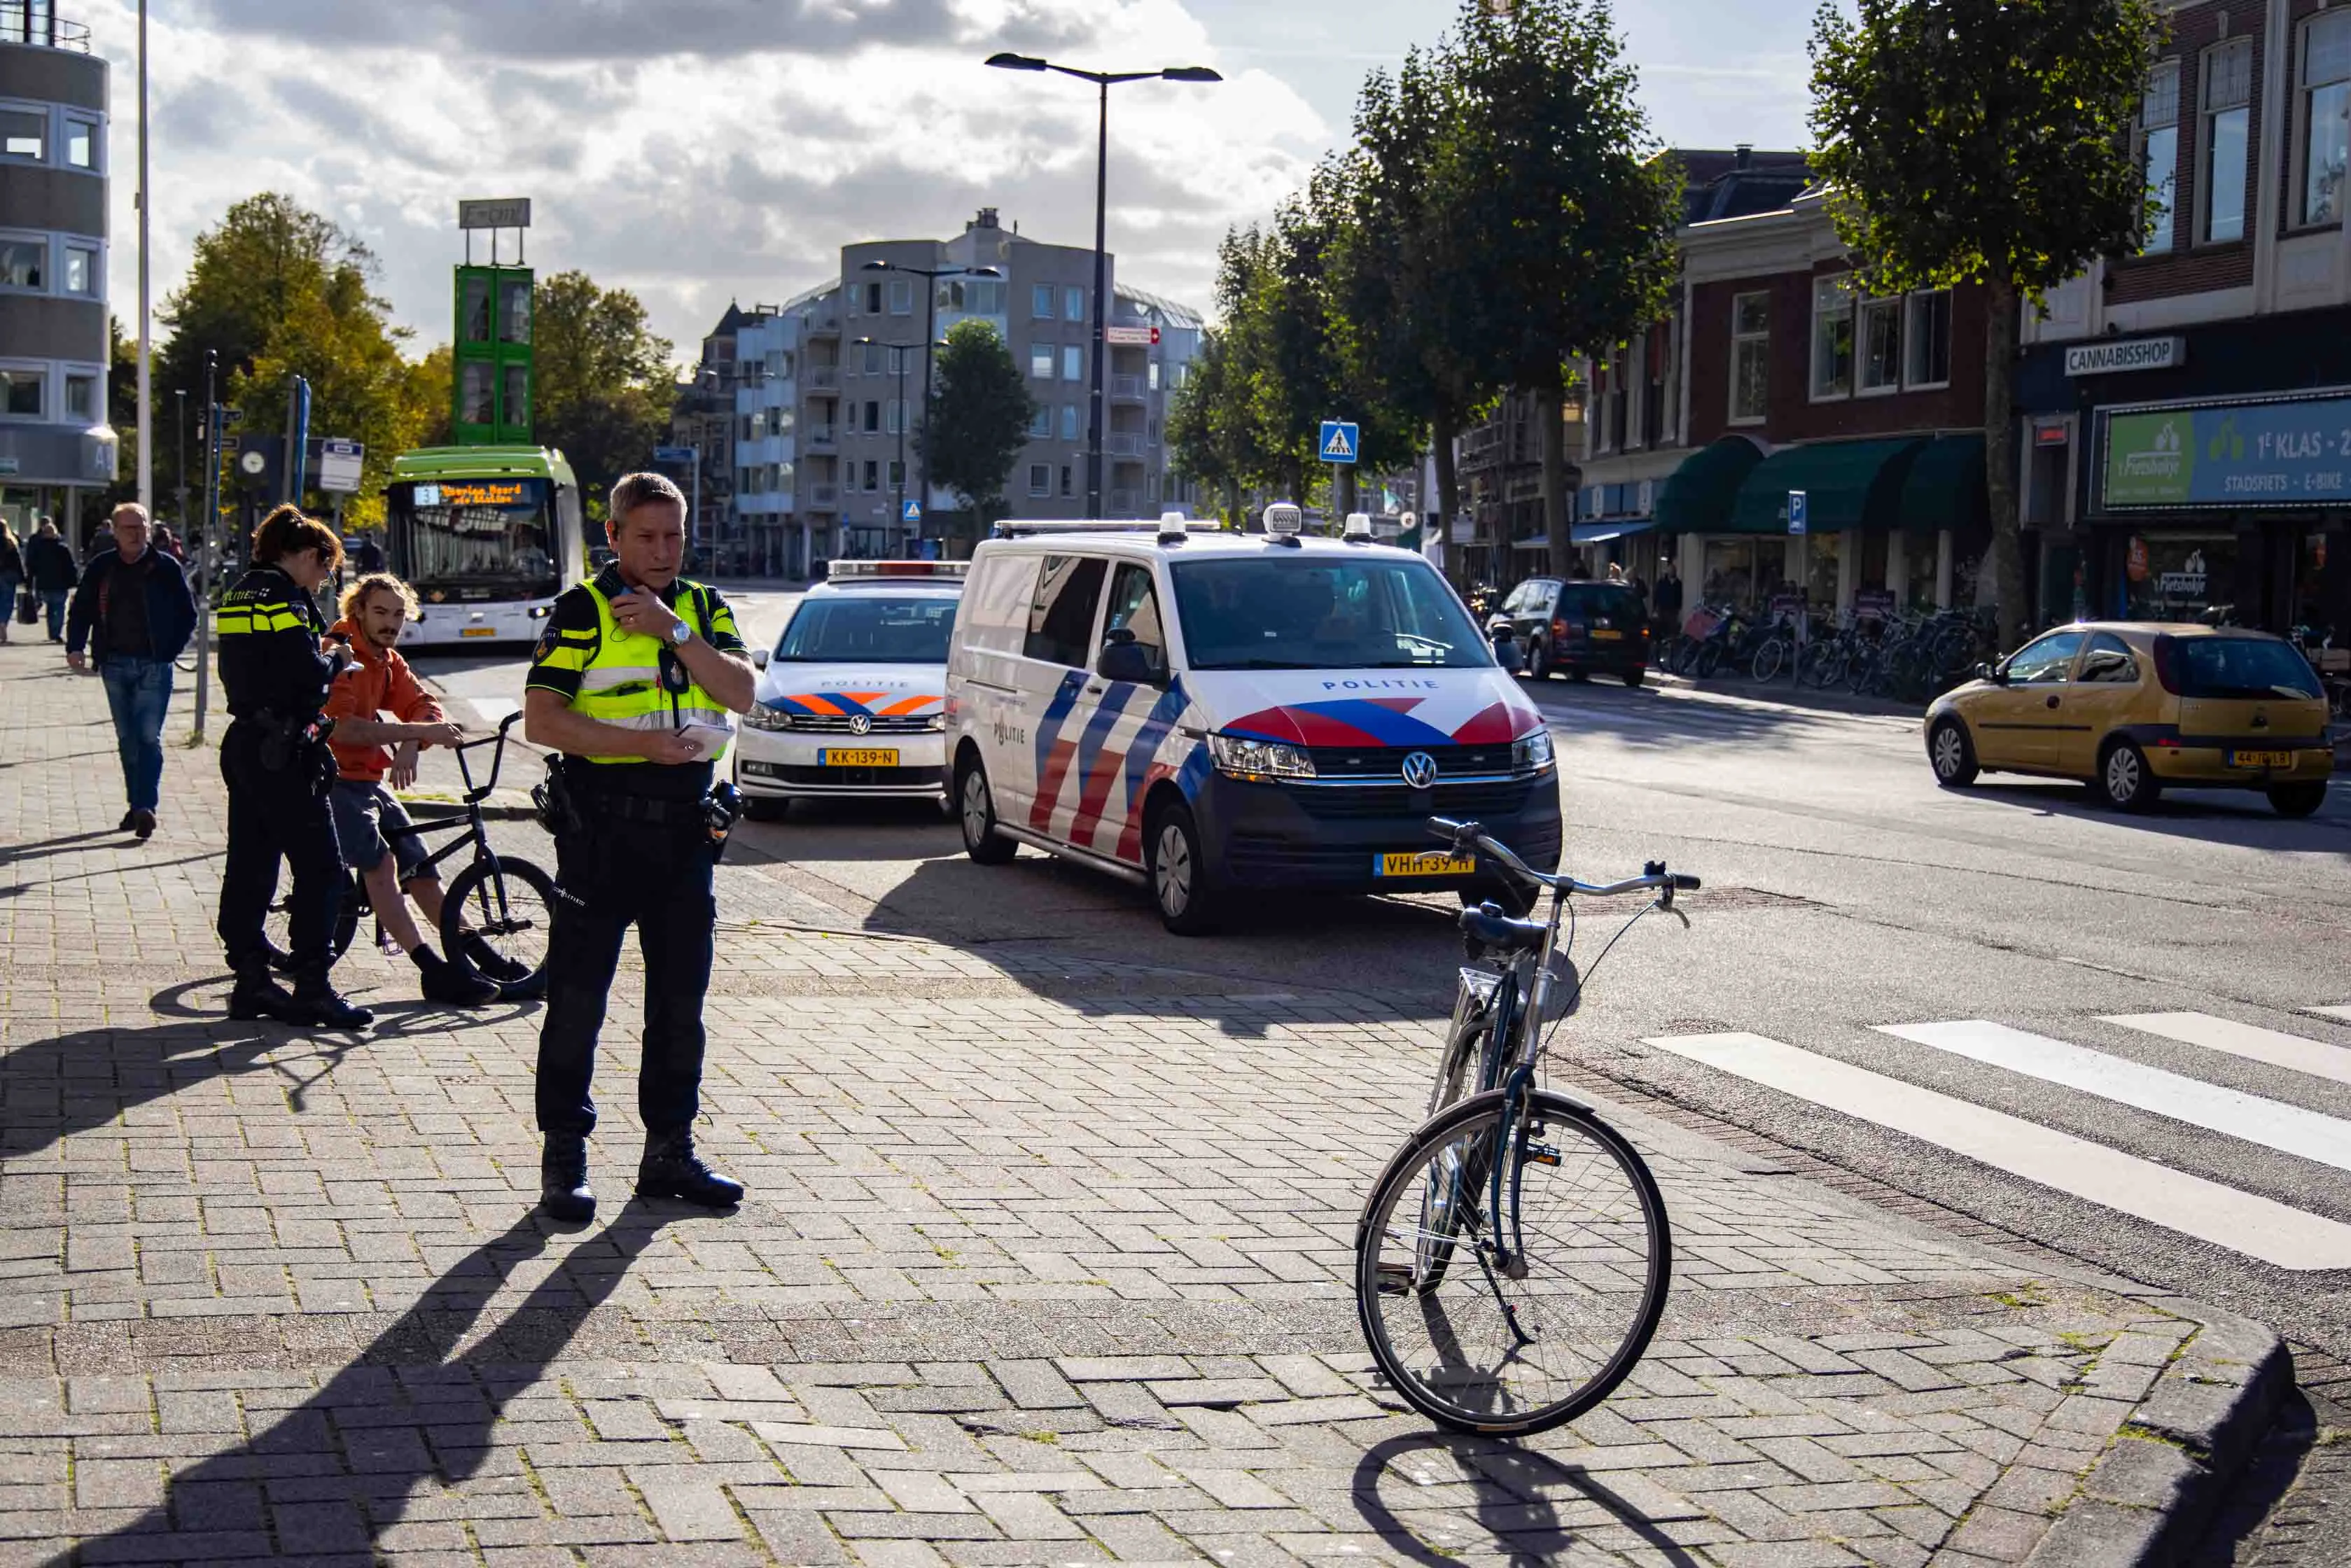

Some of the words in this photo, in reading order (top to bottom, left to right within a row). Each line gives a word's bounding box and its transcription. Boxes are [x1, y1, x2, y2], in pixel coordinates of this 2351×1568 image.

[2069, 342, 2170, 370] CANNABISSHOP
[2276, 430, 2322, 459] KLAS
[2224, 474, 2289, 493] STADSFIETS
[2305, 470, 2343, 490] E-BIKE
[1792, 496, 1802, 516] P
[1322, 680, 1439, 690] POLITIE
[994, 718, 1025, 746] POLITIE
[831, 750, 892, 764] KK-139-N
